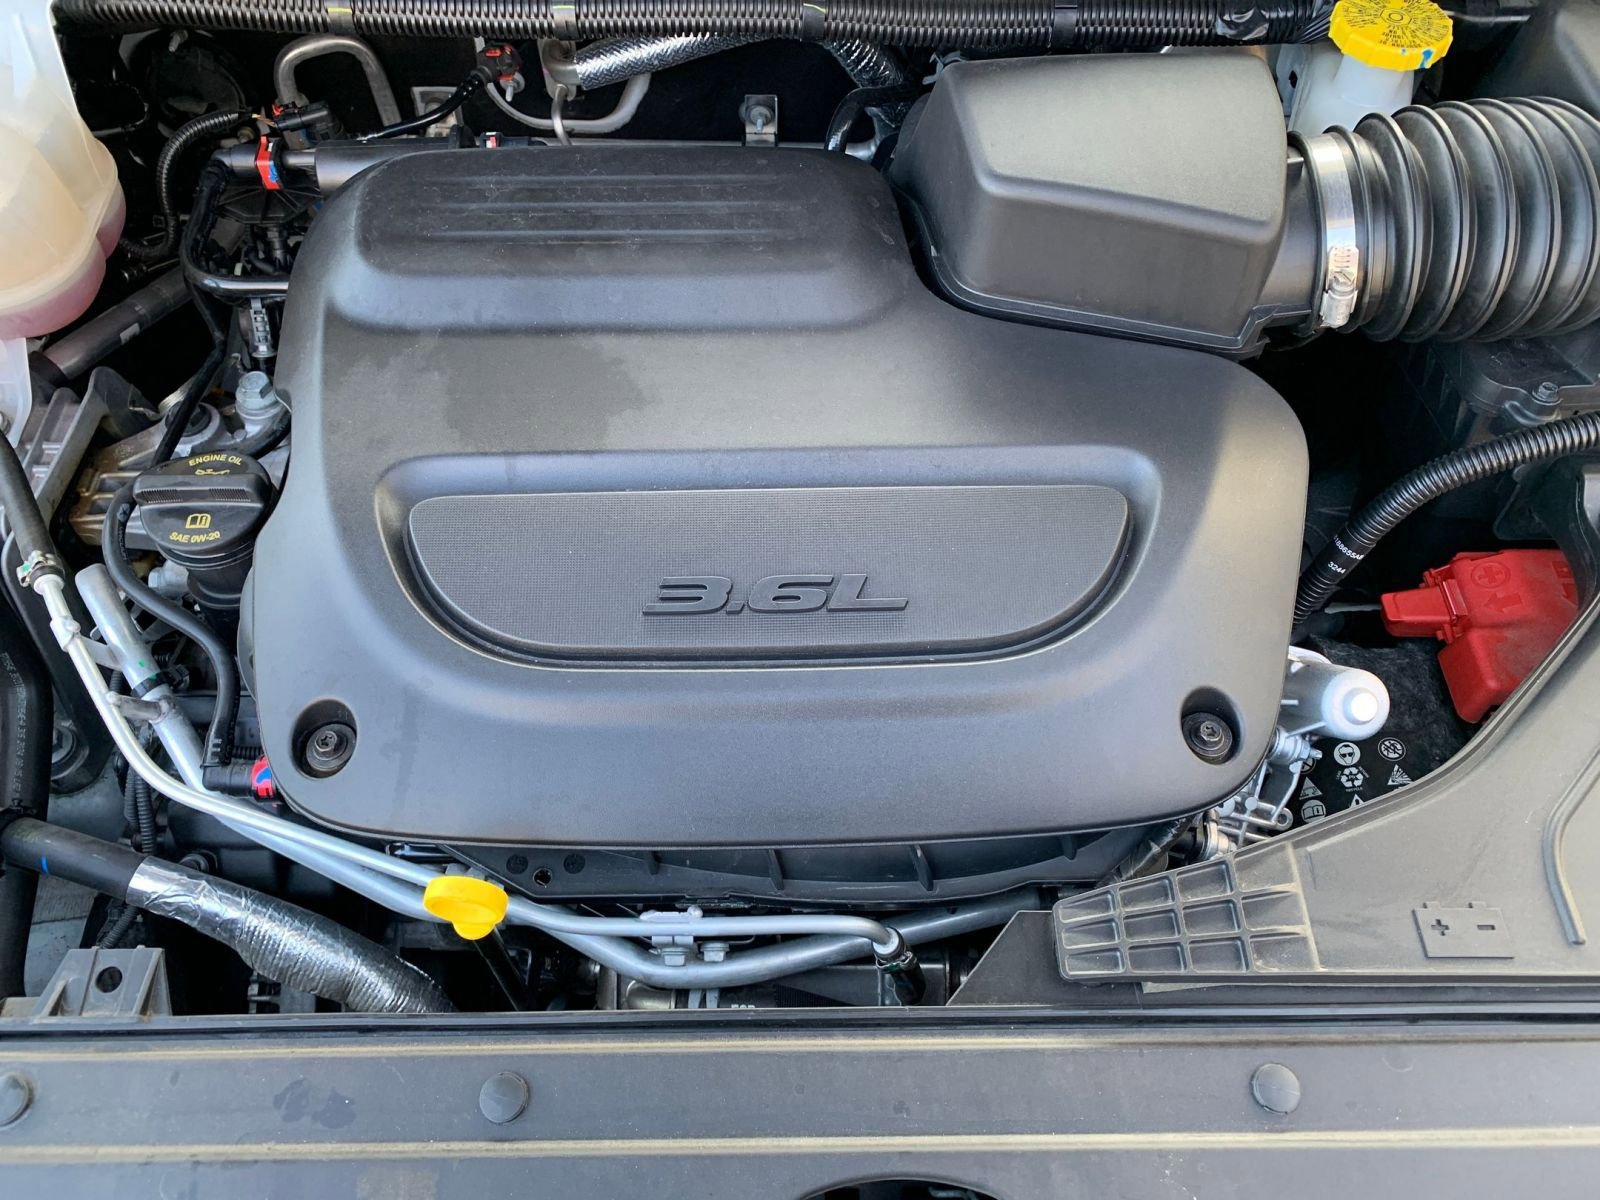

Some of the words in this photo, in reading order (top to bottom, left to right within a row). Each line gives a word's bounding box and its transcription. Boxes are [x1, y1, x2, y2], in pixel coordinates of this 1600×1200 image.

[188, 454, 227, 466] ENGINE
[228, 455, 242, 466] OIL
[169, 531, 189, 543] SAE
[191, 531, 221, 543] 0W-20
[642, 573, 909, 616] 3.6L
